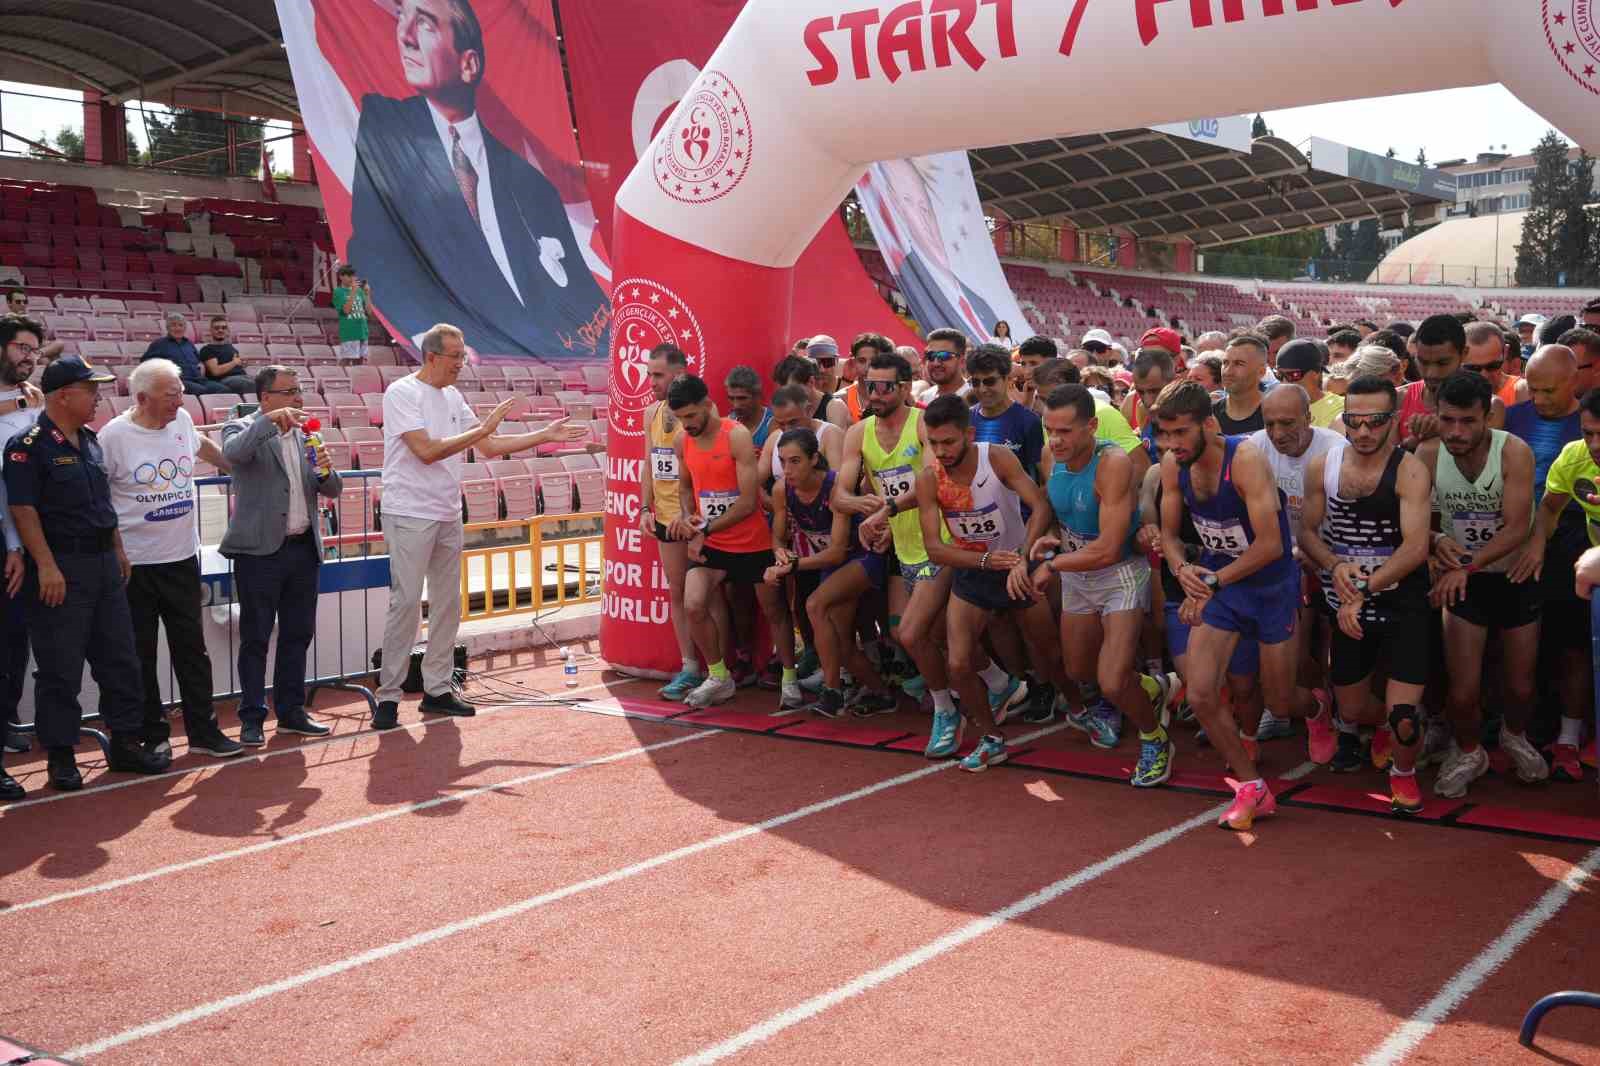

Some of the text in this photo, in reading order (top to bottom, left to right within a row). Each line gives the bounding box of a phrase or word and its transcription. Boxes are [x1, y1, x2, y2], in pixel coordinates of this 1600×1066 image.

[801, 0, 1018, 86] START
[657, 460, 673, 473] 85
[135, 489, 184, 503] OLYMPIC
[1445, 490, 1504, 502] ANATOLI
[152, 503, 193, 518] SAMSUN
[707, 502, 735, 516] 29
[959, 520, 996, 535] 128
[615, 527, 642, 553] VE
[1202, 533, 1239, 550] 225
[601, 590, 669, 625] DÜRLÜ
